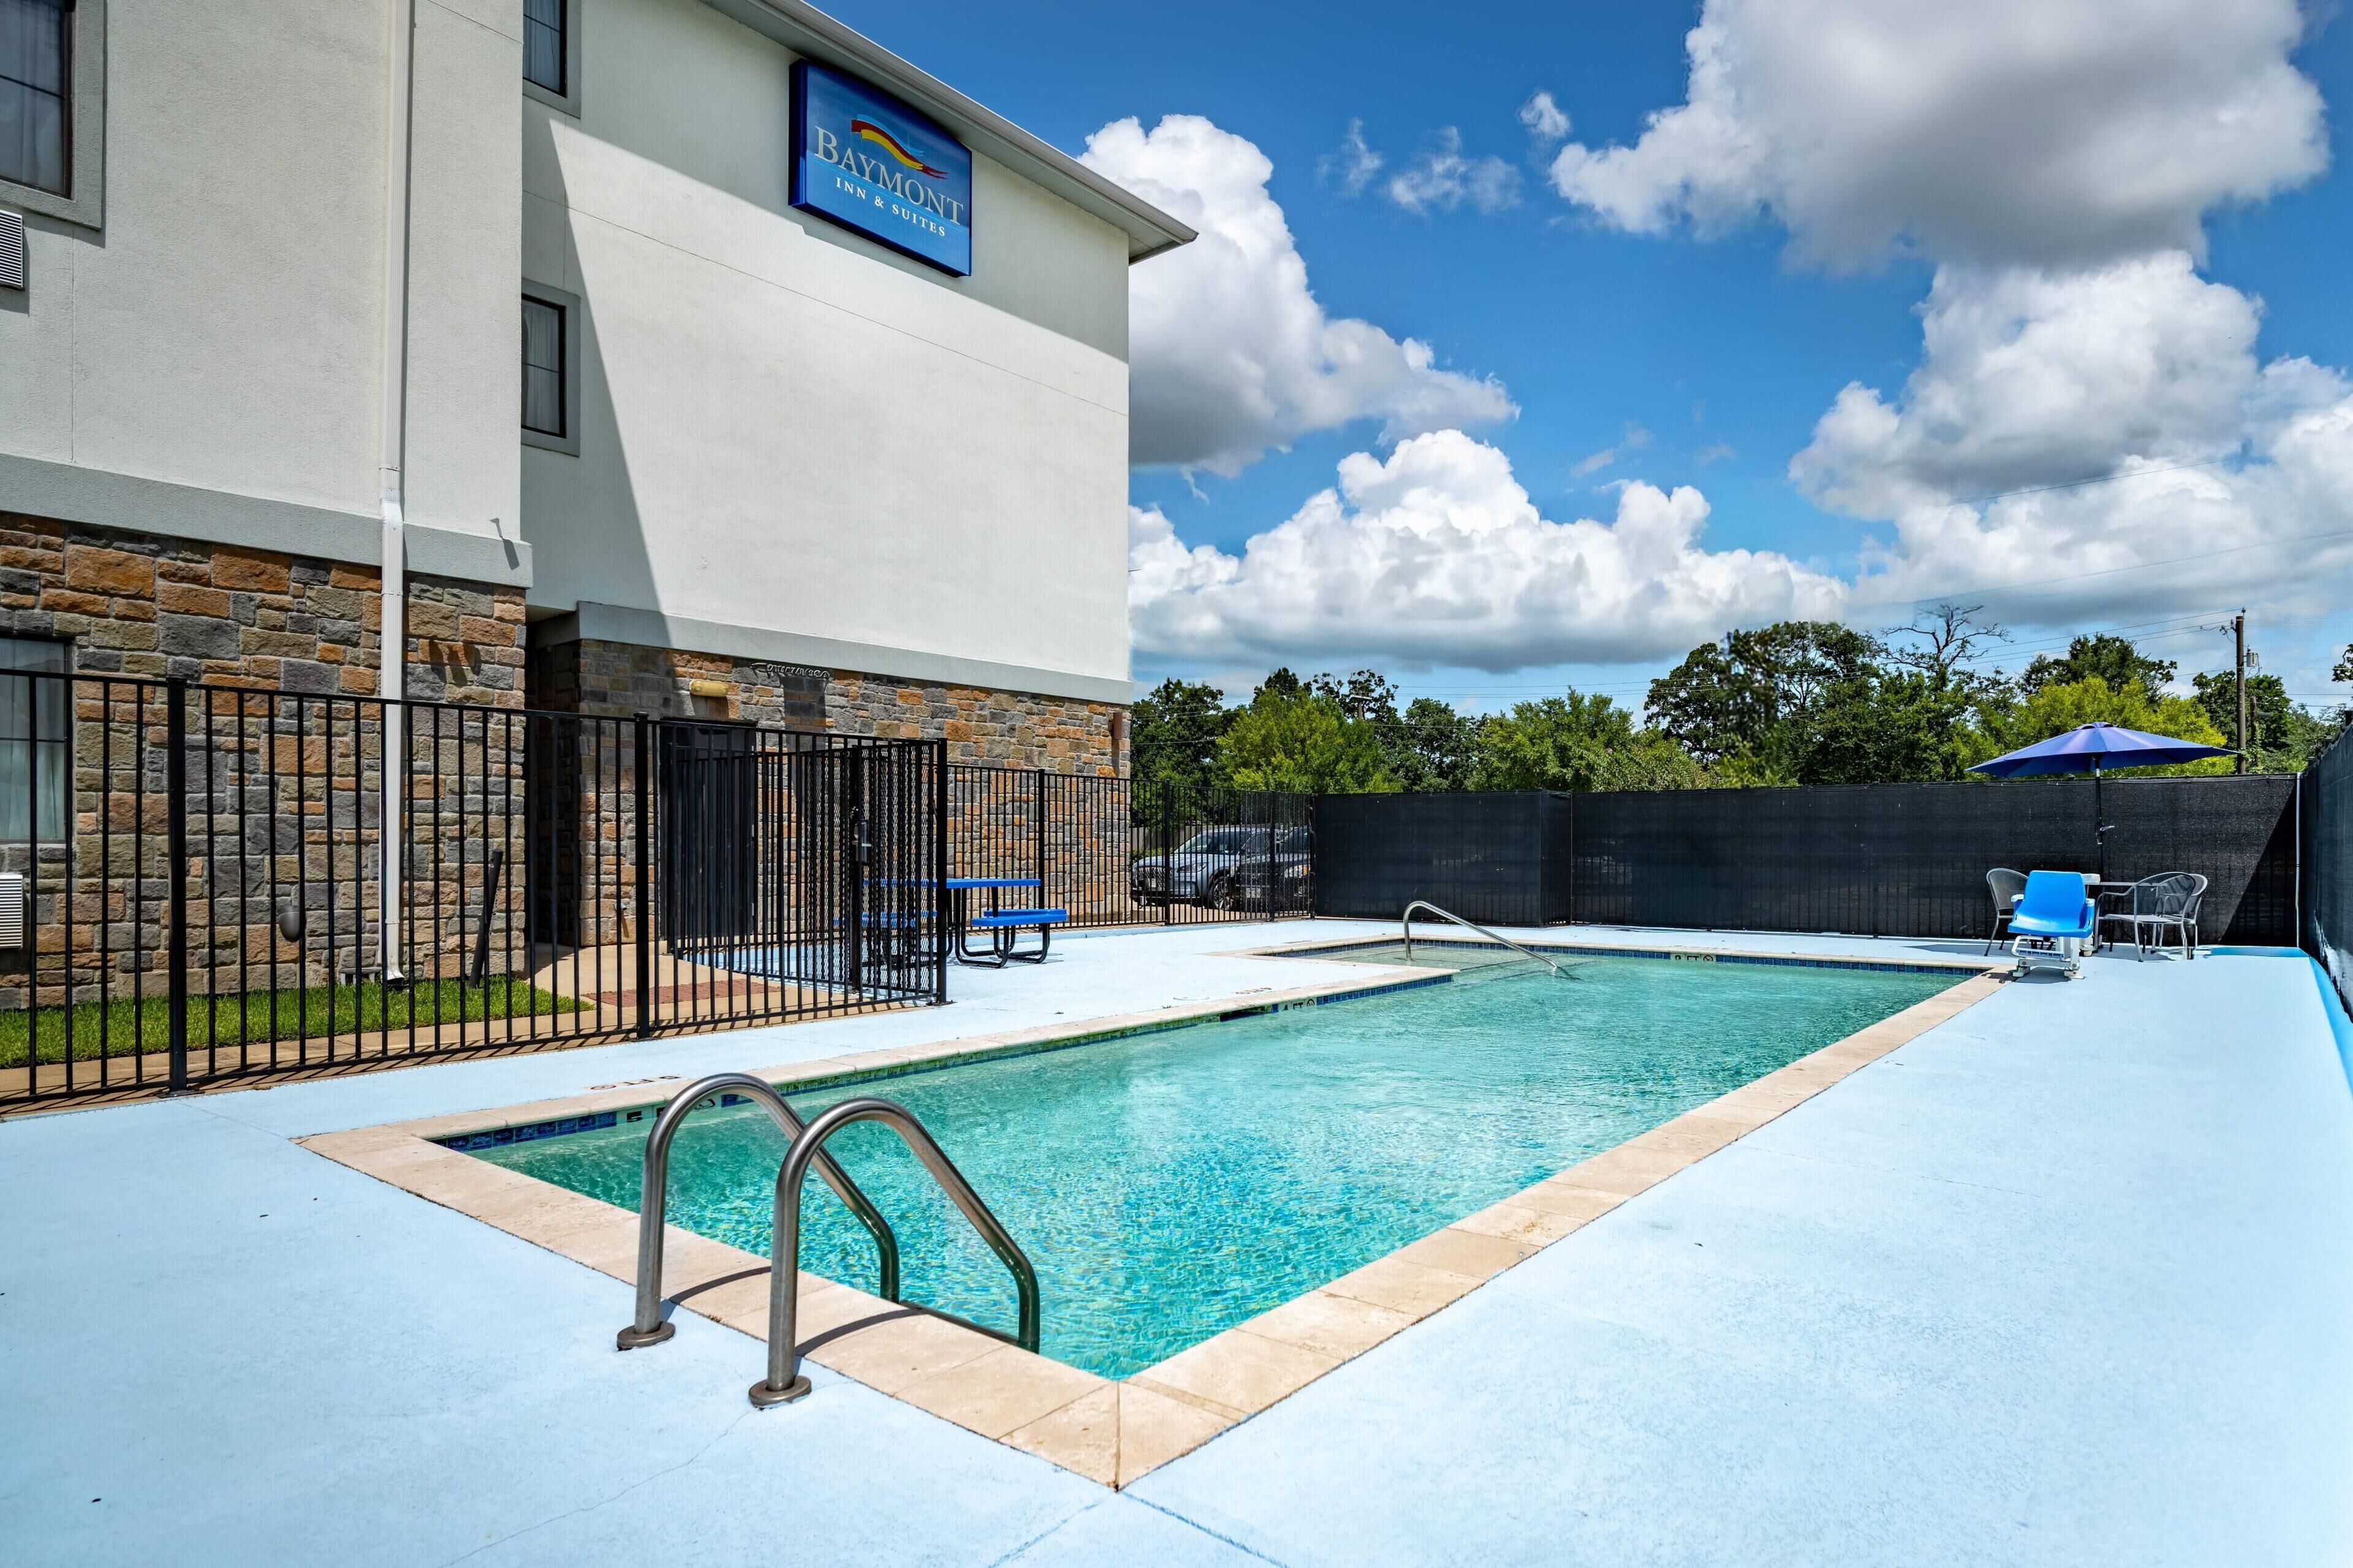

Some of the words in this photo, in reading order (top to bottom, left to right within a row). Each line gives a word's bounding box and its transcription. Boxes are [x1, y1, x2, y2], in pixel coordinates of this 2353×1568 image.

[814, 125, 964, 225] BAYMONT
[836, 176, 866, 200] INN
[874, 195, 884, 209] &
[892, 204, 945, 237] SUITES
[627, 1111, 643, 1123] 5
